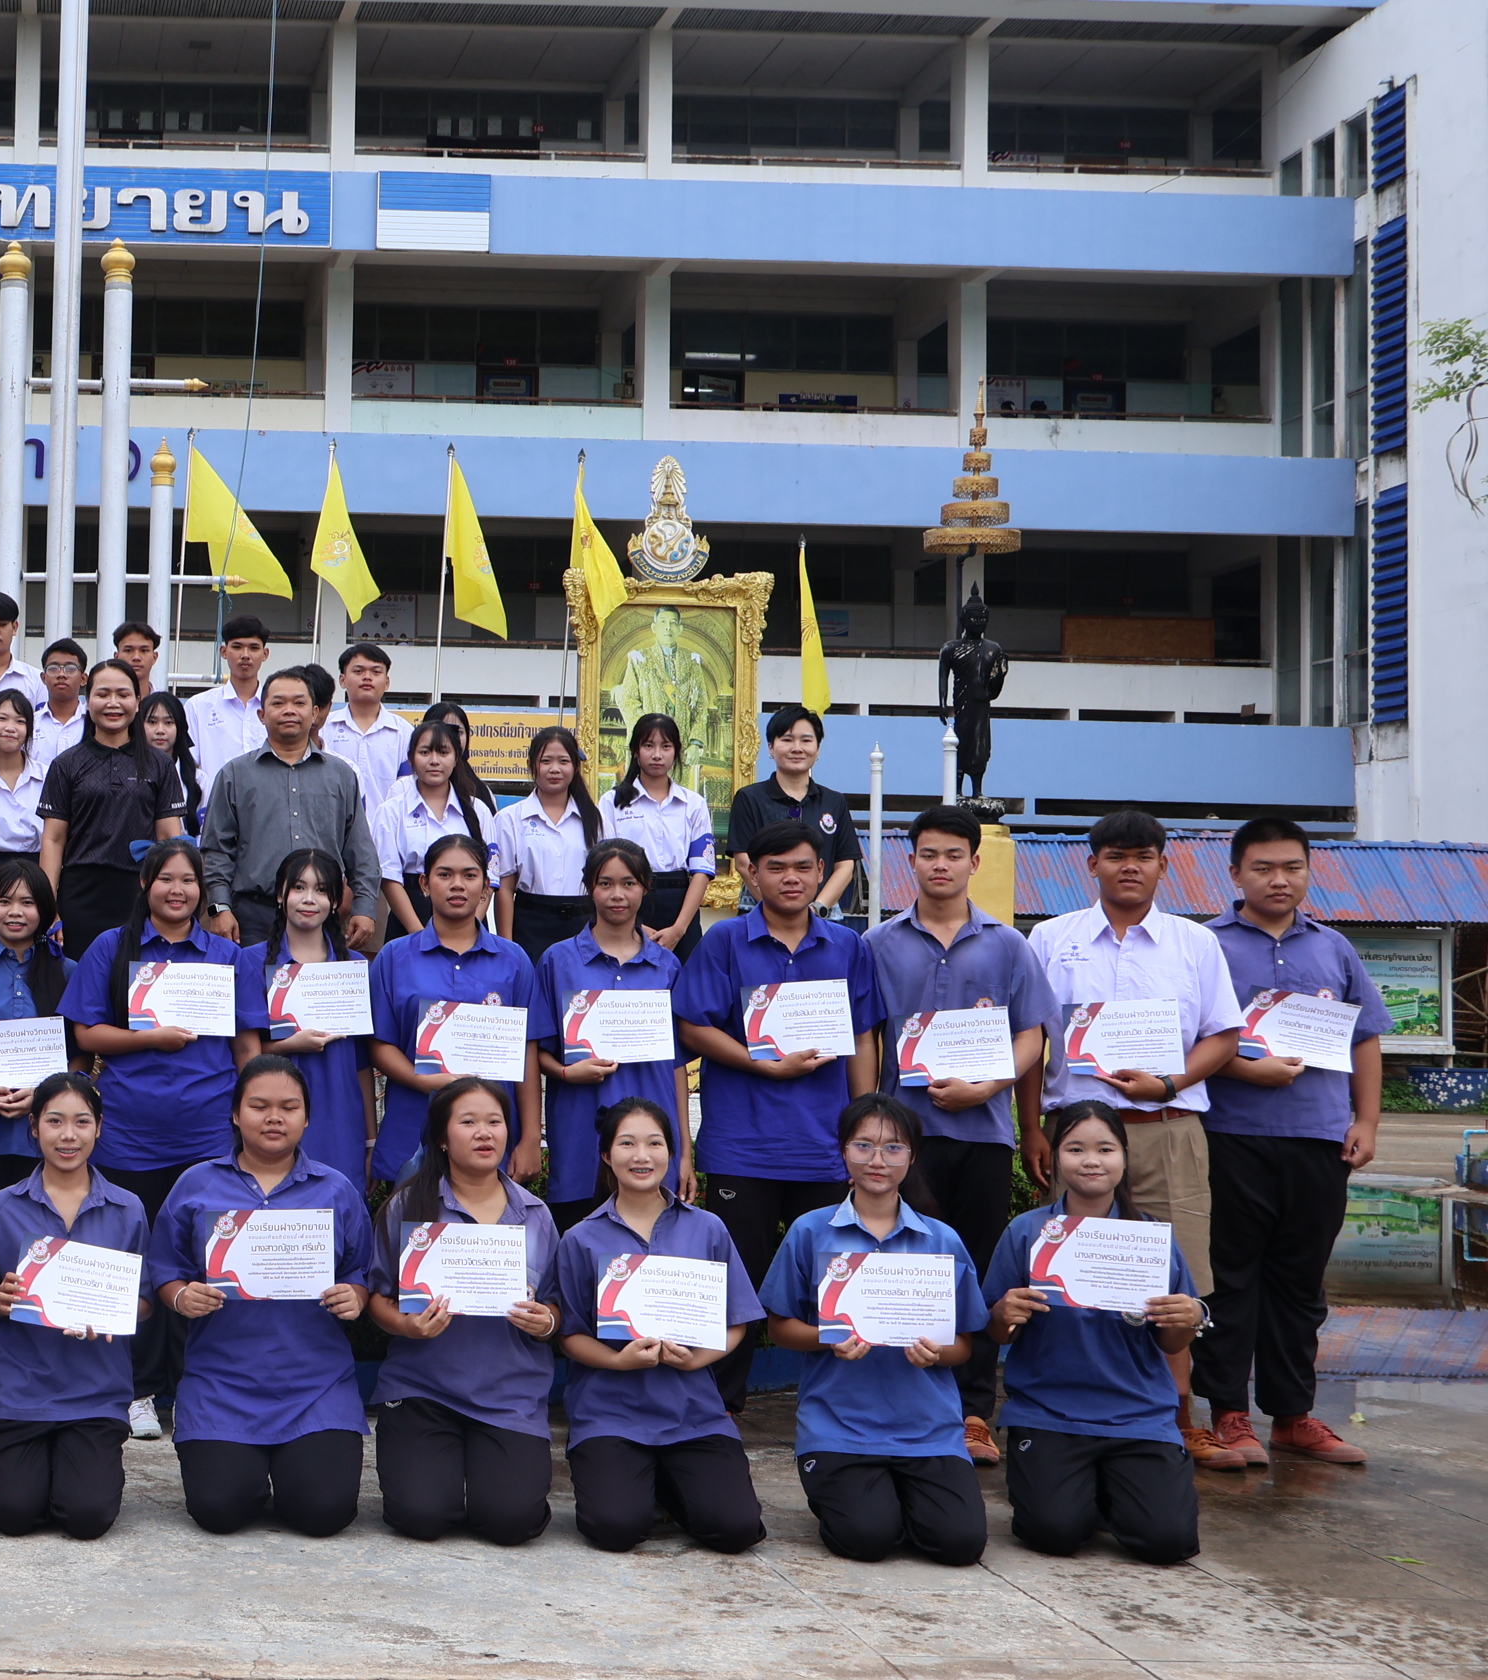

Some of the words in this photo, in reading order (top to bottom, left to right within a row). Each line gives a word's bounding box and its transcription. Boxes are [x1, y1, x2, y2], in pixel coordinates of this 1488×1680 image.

[163, 972, 231, 982] โรงเรียนฝางวิทยายน
[298, 972, 366, 981] โรงเรียนฝางวิทยายน
[776, 991, 846, 1001] โรงเรียนฝางวิทยายน
[596, 1000, 668, 1008] โรงเรียนฝางวิทยายน
[1099, 1010, 1176, 1020] โรงเรียนฝางวิทยายน
[1281, 1001, 1354, 1021] โรงเรียนฝางวิทยายน
[453, 1012, 523, 1025] โรงเรียนฝางวิทยายน
[931, 1018, 1006, 1030] โรงเรียนฝางวิทยายน
[246, 1222, 330, 1231] โรงเรียนฝางวิทยายน
[440, 1235, 522, 1246] โรงเรียนฝางวิทยายน
[1076, 1229, 1166, 1244] โรงเรียนฝางวิทยายน
[302, 1242, 325, 1251] ศรีแก้ว
[58, 1251, 137, 1274] โรงเรียนฝางวิทยายน
[639, 1266, 723, 1283] โรงเรียนฝางวิทยายน
[861, 1265, 950, 1276] โรงเรียนฝางวิทยายน
[861, 1288, 909, 1296] นางสาวชลธิชา
